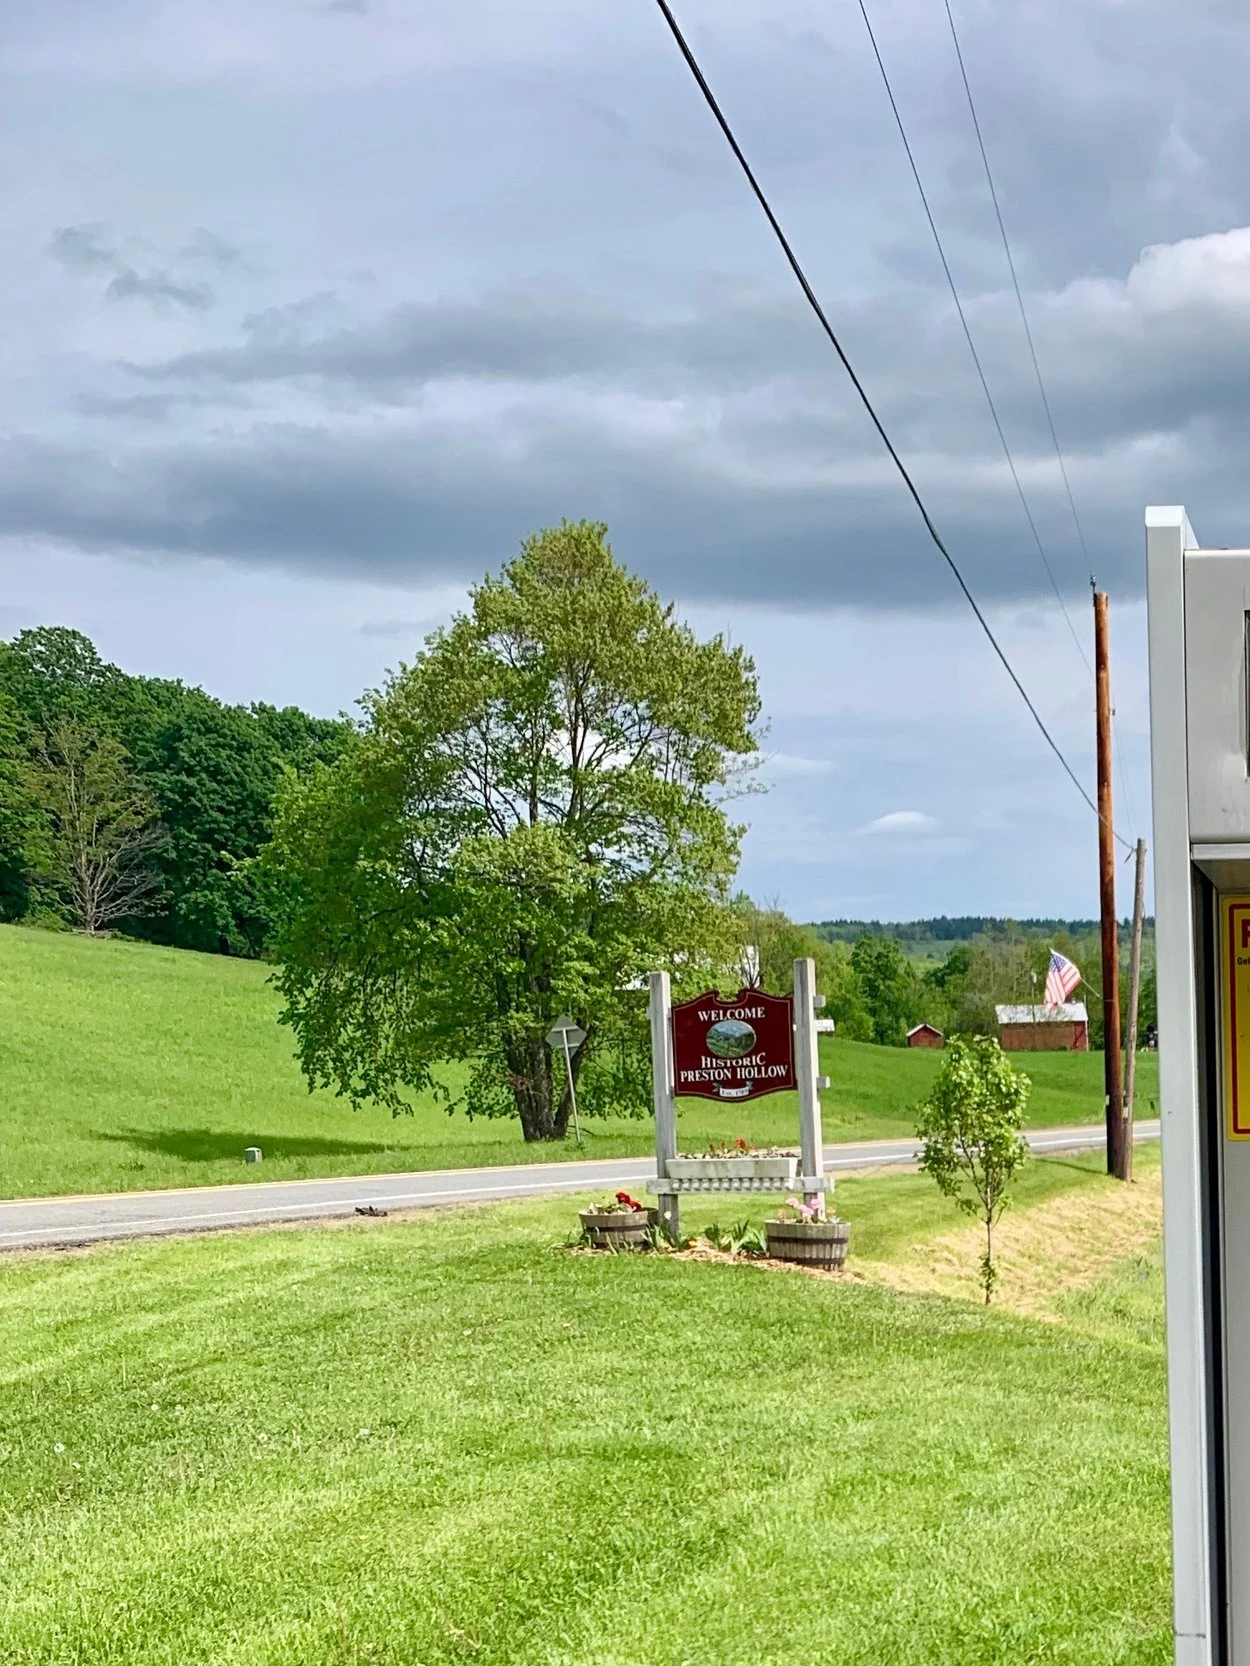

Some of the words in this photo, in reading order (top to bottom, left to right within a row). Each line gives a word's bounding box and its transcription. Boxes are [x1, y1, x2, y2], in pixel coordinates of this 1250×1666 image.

[1237, 957, 1250, 966] Get
[698, 1006, 765, 1022] WELCOME
[701, 1052, 766, 1068] HISTORIC
[680, 1068, 732, 1082] PRESTON
[737, 1065, 788, 1079] HOLLOW
